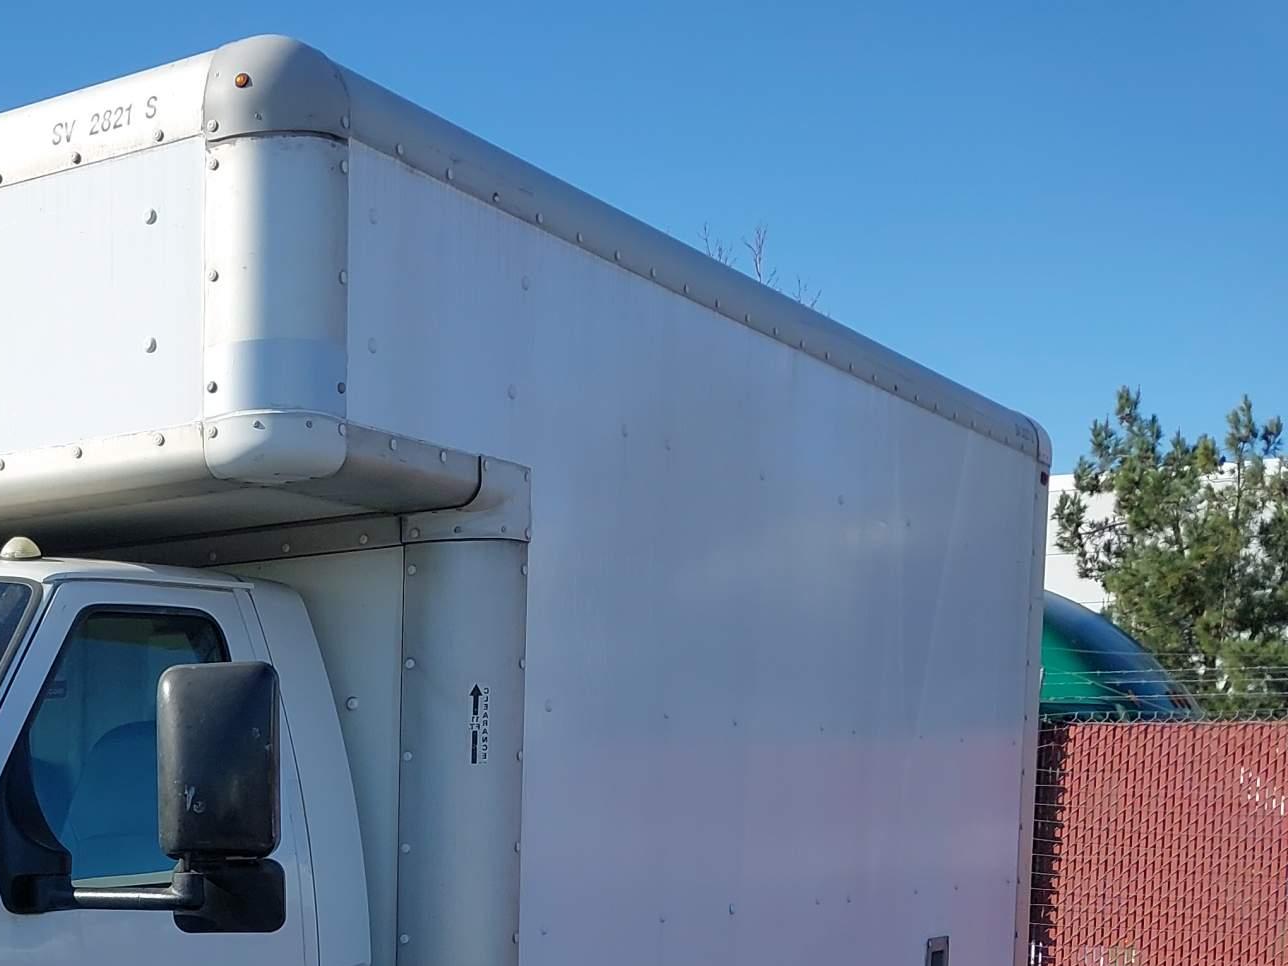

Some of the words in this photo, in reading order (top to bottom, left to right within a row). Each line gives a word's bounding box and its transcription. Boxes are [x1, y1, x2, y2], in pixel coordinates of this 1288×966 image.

[52, 120, 76, 146] SV
[89, 104, 133, 136] 2821
[145, 96, 158, 119] S
